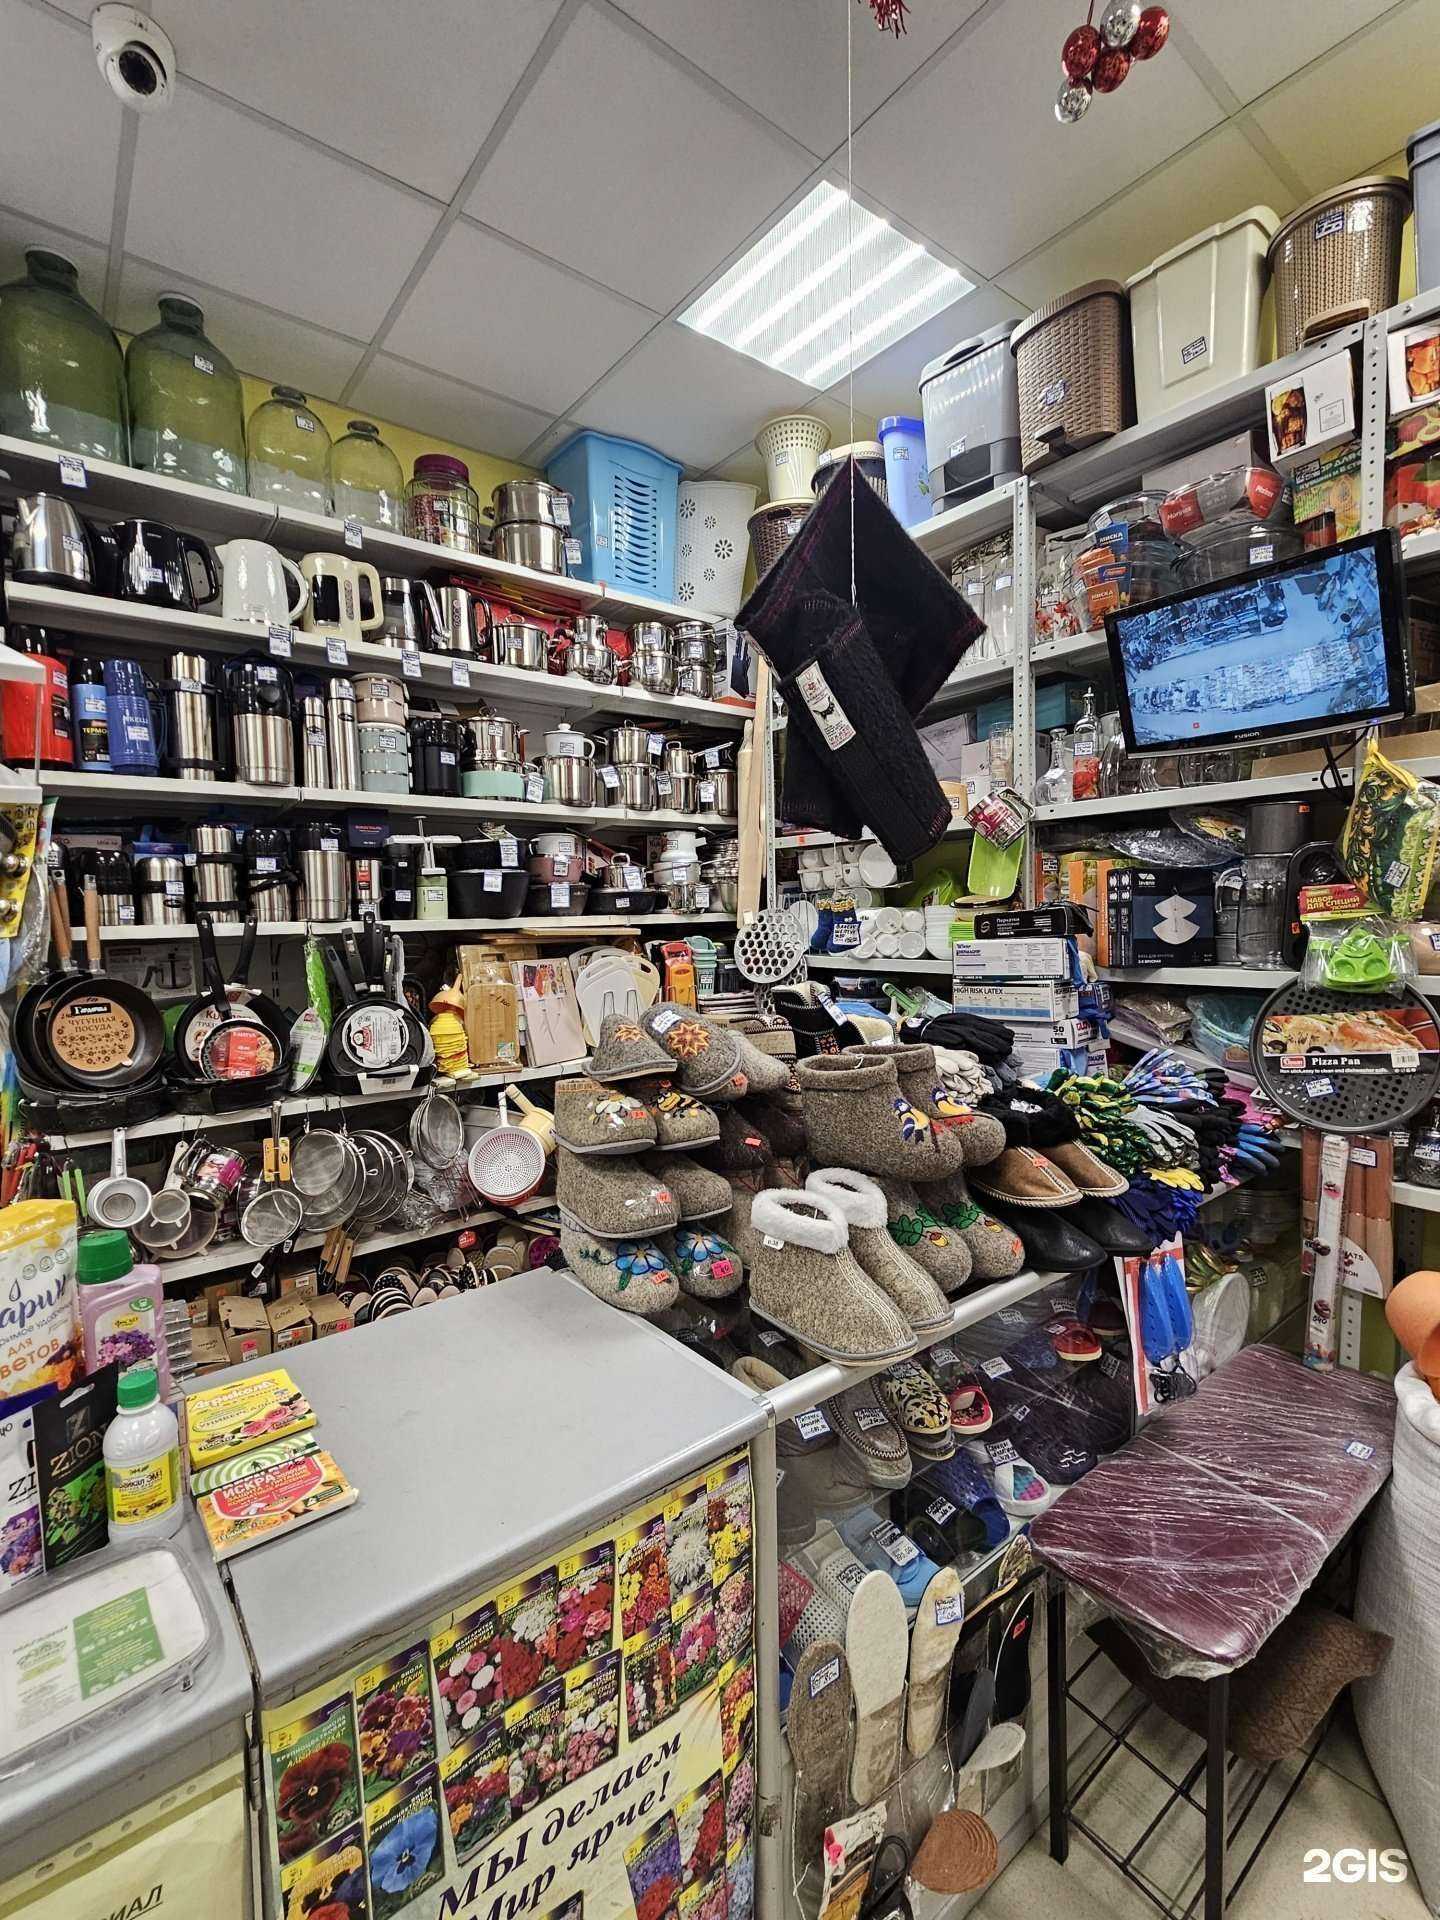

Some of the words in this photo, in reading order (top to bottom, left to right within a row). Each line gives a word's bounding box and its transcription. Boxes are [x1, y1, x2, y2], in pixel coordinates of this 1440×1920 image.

[1100, 532, 1123, 543] МИСКА
[1306, 896, 1333, 904] НАБОР
[1307, 902, 1324, 911] ДЛЯ
[1325, 895, 1360, 907] СПЕЦИЙ
[68, 1016, 116, 1026] ЧУГУННАЯ
[75, 1024, 112, 1032] ПОСУДА
[1311, 1057, 1338, 1066] Pizza
[1341, 1057, 1361, 1066] Pan
[7, 1338, 34, 1357] ДЛЯ
[0, 1338, 60, 1380] ВЕТОВ
[8, 1472, 37, 1501] ZI
[222, 1471, 276, 1499] ИСКРА
[400, 1663, 424, 1679] ВИОЛА
[438, 1827, 533, 1920] МЫ
[541, 1731, 682, 1848] делаем
[565, 1770, 672, 1871] ярче!
[107, 1884, 163, 1920] ИАЛ
